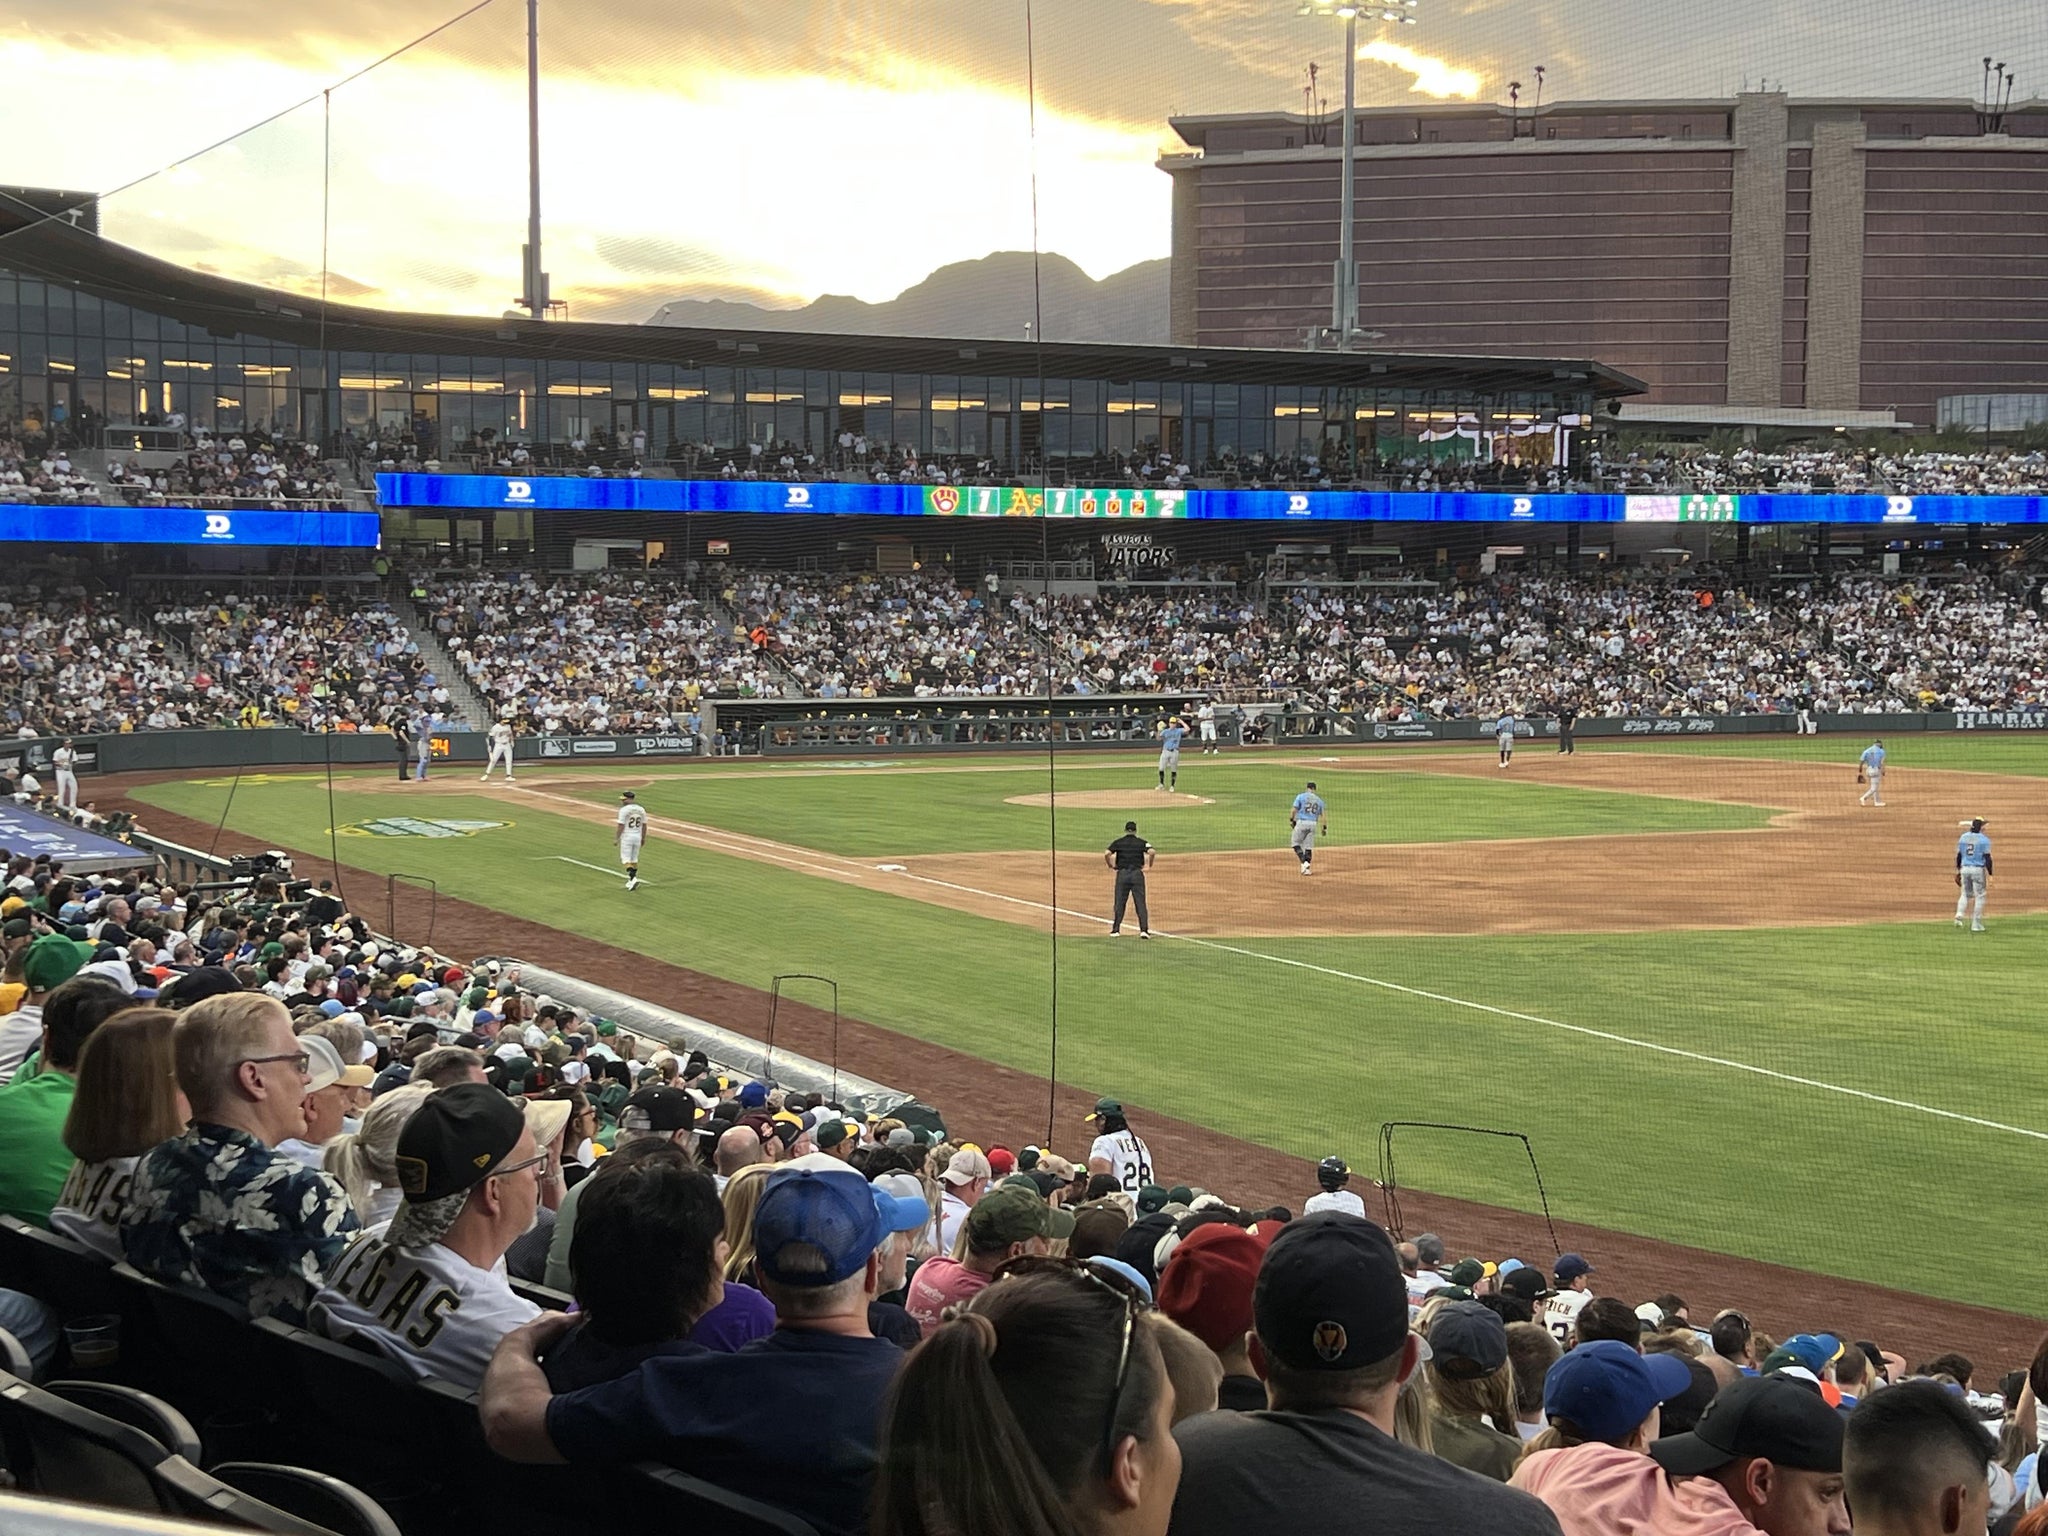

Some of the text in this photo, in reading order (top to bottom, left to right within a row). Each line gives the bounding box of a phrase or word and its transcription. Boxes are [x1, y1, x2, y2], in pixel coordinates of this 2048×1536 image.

[979, 490, 991, 513] 1
[1055, 491, 1067, 513] 1
[1160, 499, 1176, 515] 2
[634, 737, 693, 750] TED WIENS
[1966, 843, 1976, 856] 2
[1122, 1161, 1153, 1192] 28
